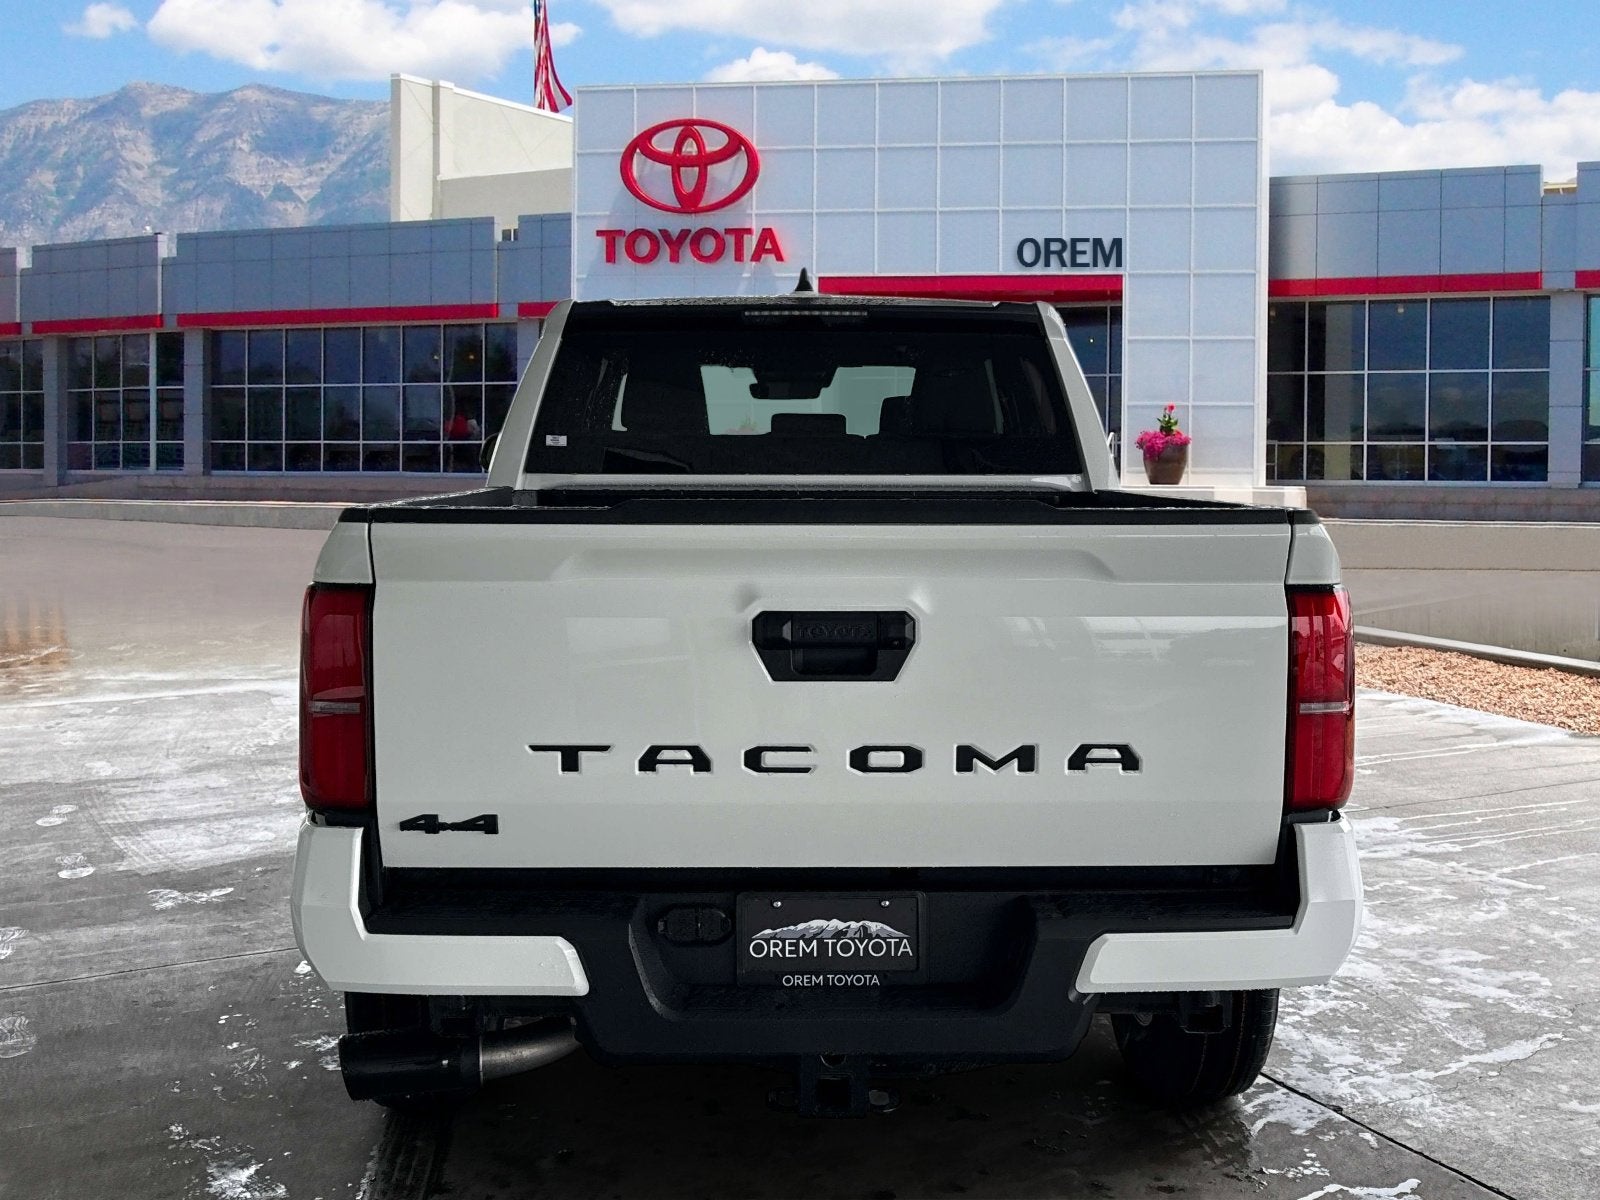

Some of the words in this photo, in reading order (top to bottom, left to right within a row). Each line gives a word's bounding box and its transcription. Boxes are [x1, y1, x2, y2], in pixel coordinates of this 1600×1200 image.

[596, 227, 785, 264] TOYOTA
[1016, 237, 1123, 268] OREM
[528, 744, 1141, 774] TACOMA
[749, 939, 818, 958] OREM
[824, 938, 913, 957] TOYOTA
[782, 975, 824, 986] OREM
[828, 974, 880, 986] TOYOTA
